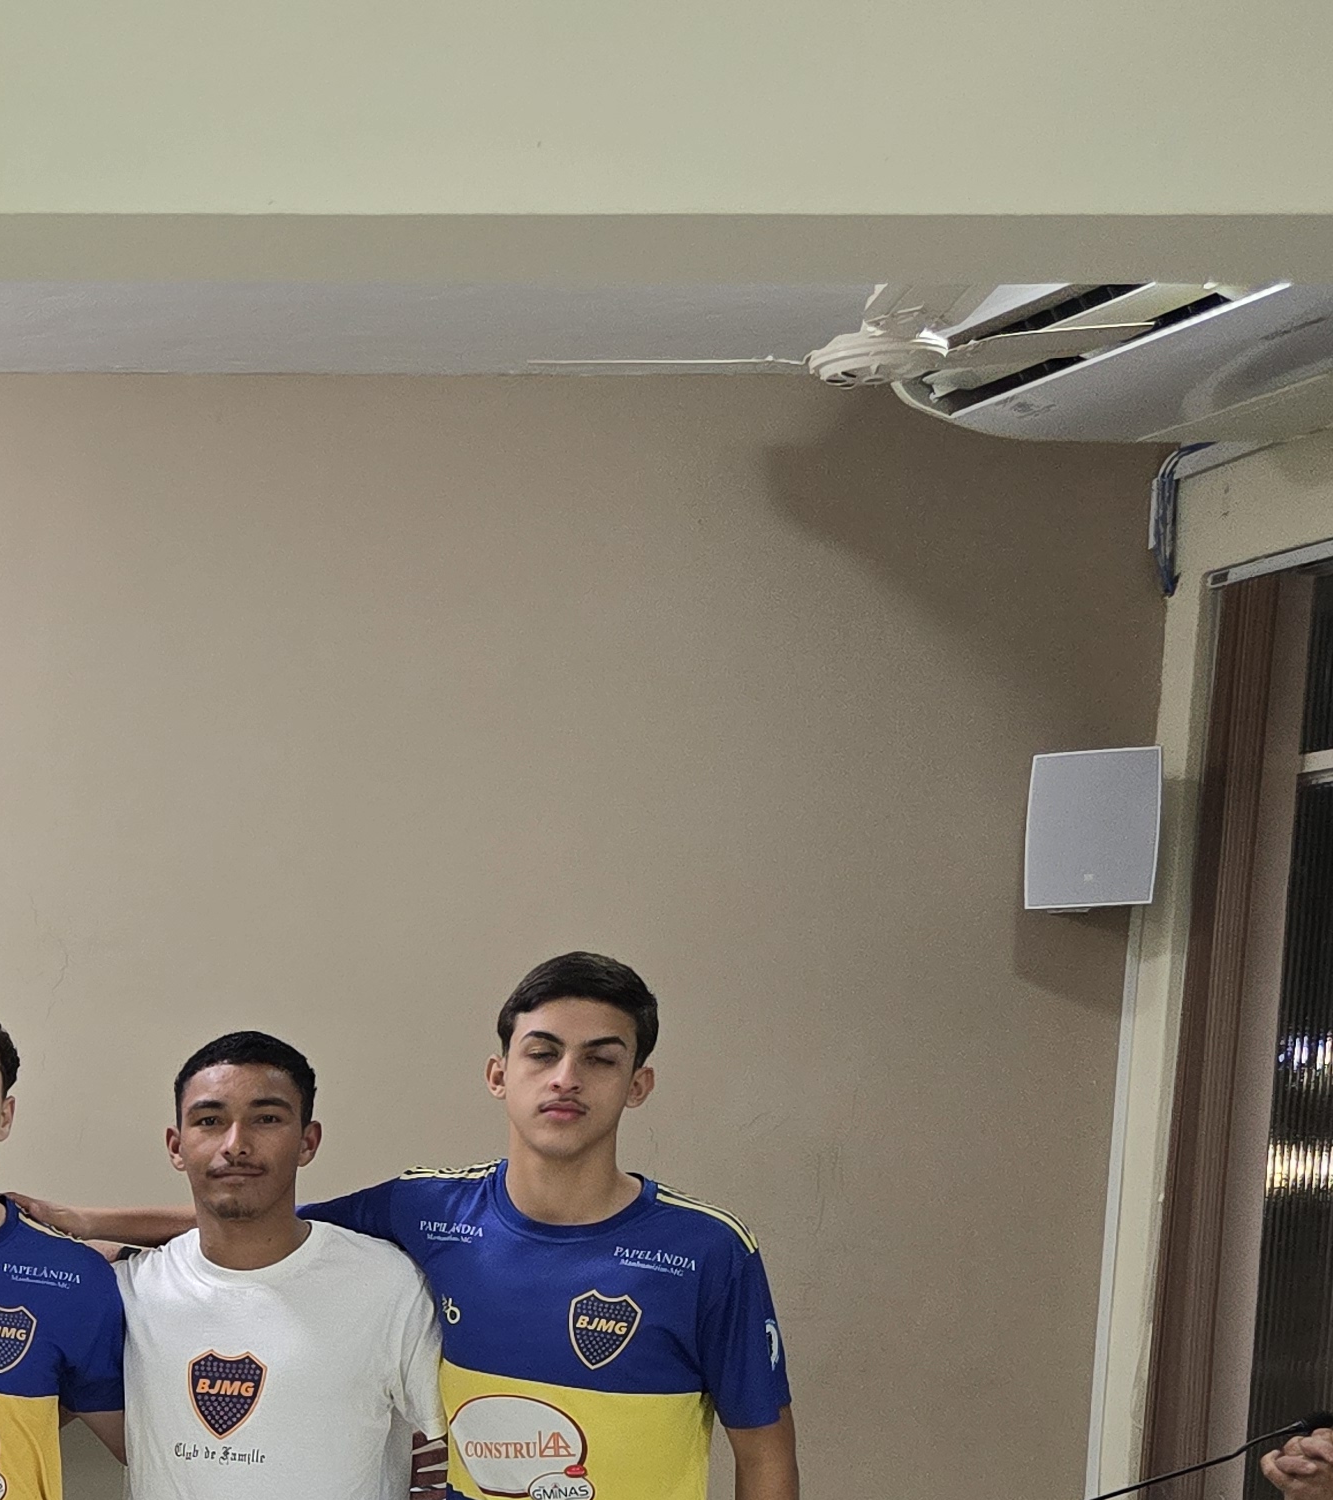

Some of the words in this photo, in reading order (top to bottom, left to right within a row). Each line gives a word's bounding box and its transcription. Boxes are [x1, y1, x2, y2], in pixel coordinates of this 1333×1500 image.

[576, 1314, 629, 1336] BJMG
[195, 1378, 255, 1397] BJMG
[204, 1446, 217, 1459] de
